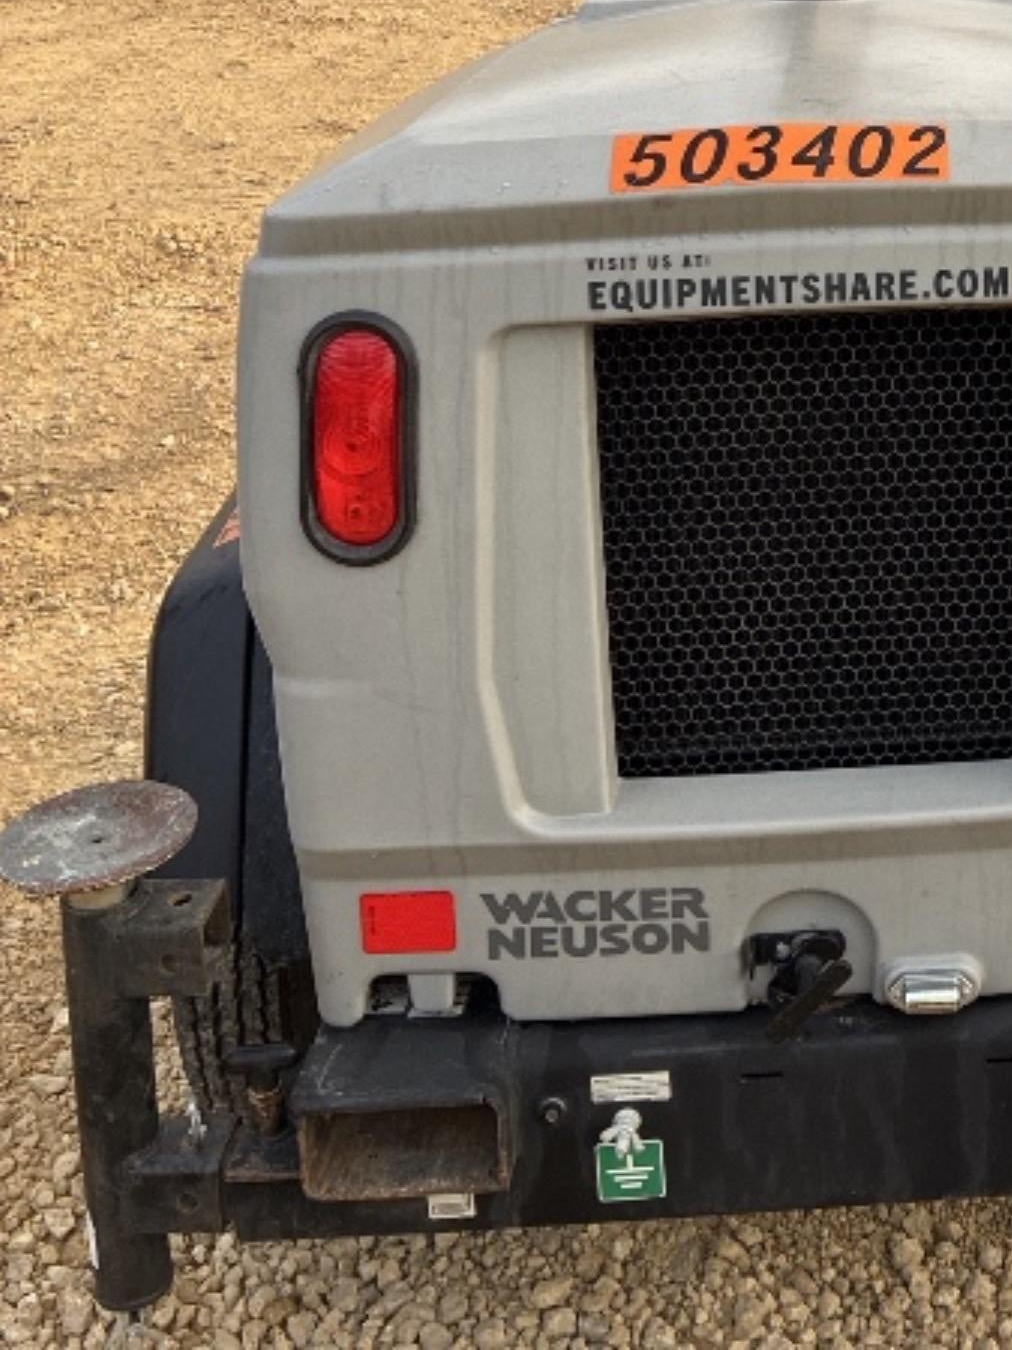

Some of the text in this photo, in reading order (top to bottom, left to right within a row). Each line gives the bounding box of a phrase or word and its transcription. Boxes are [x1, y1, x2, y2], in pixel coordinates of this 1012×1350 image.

[623, 124, 947, 187] 503402
[586, 257, 637, 271] VISIT
[647, 254, 672, 270] US
[588, 268, 1009, 312] EQUIPMENTSHARE.COM
[480, 887, 709, 924] WACKER
[488, 922, 711, 961] NEUSON
